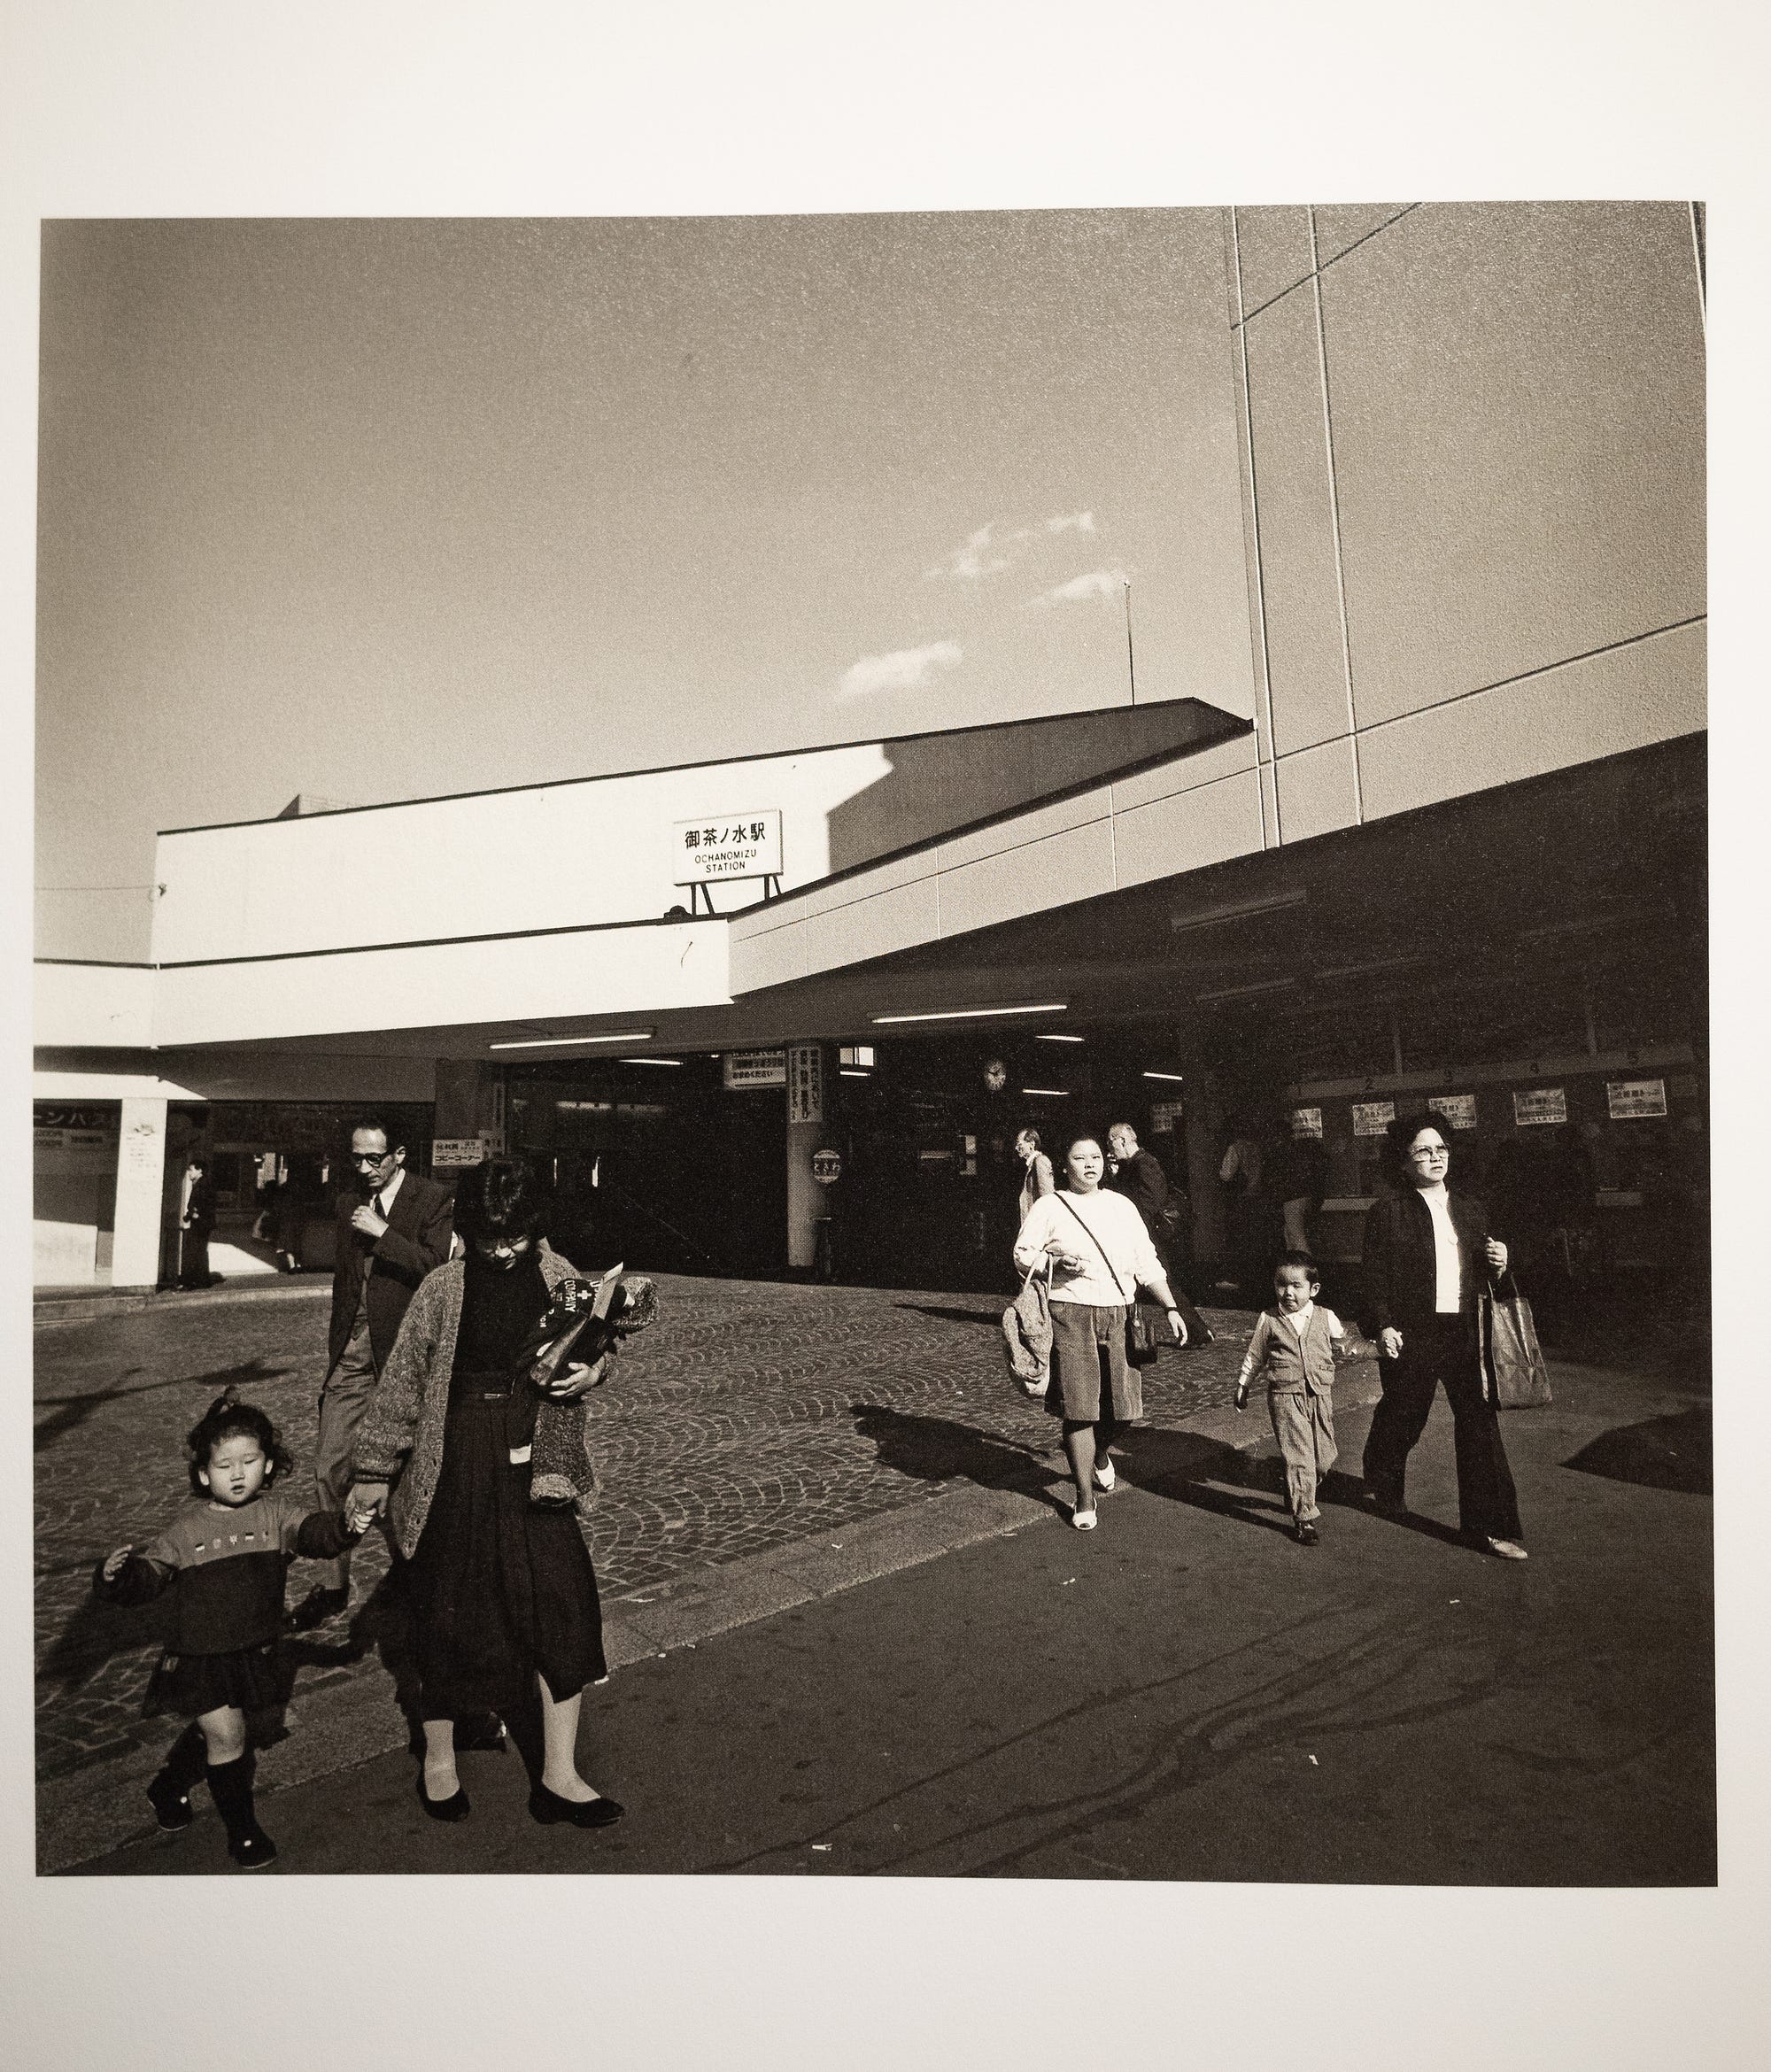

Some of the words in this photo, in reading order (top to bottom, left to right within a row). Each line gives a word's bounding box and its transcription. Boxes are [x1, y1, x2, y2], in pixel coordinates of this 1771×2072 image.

[684, 822, 765, 849] 御茶ノ水駅
[694, 849, 757, 864] OCHANOMIZU
[706, 862, 746, 873] STATION
